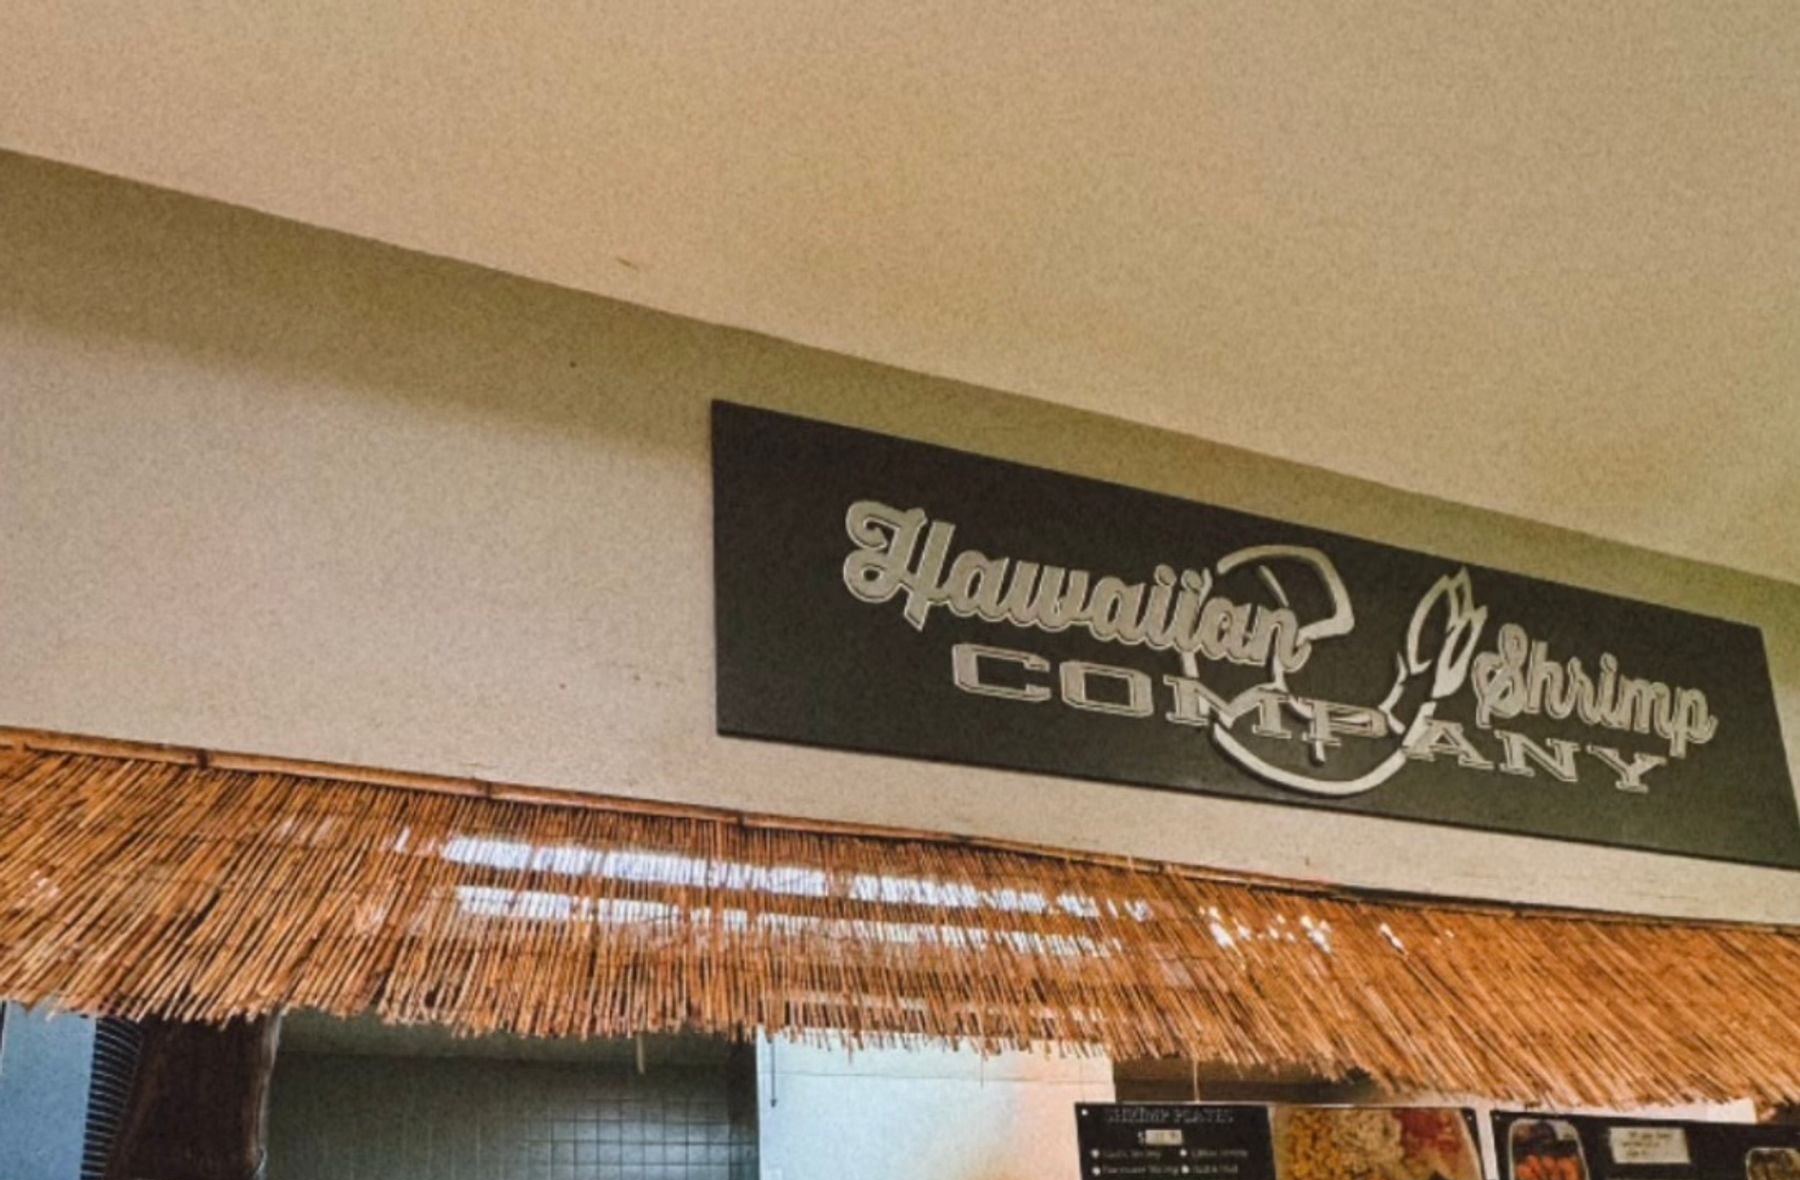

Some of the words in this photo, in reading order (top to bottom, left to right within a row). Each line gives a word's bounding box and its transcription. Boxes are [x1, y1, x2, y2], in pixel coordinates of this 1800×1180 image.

[842, 500, 1313, 674] Hawaiian
[1471, 622, 1719, 760] Shrimp
[952, 642, 1667, 794] COMPANY
